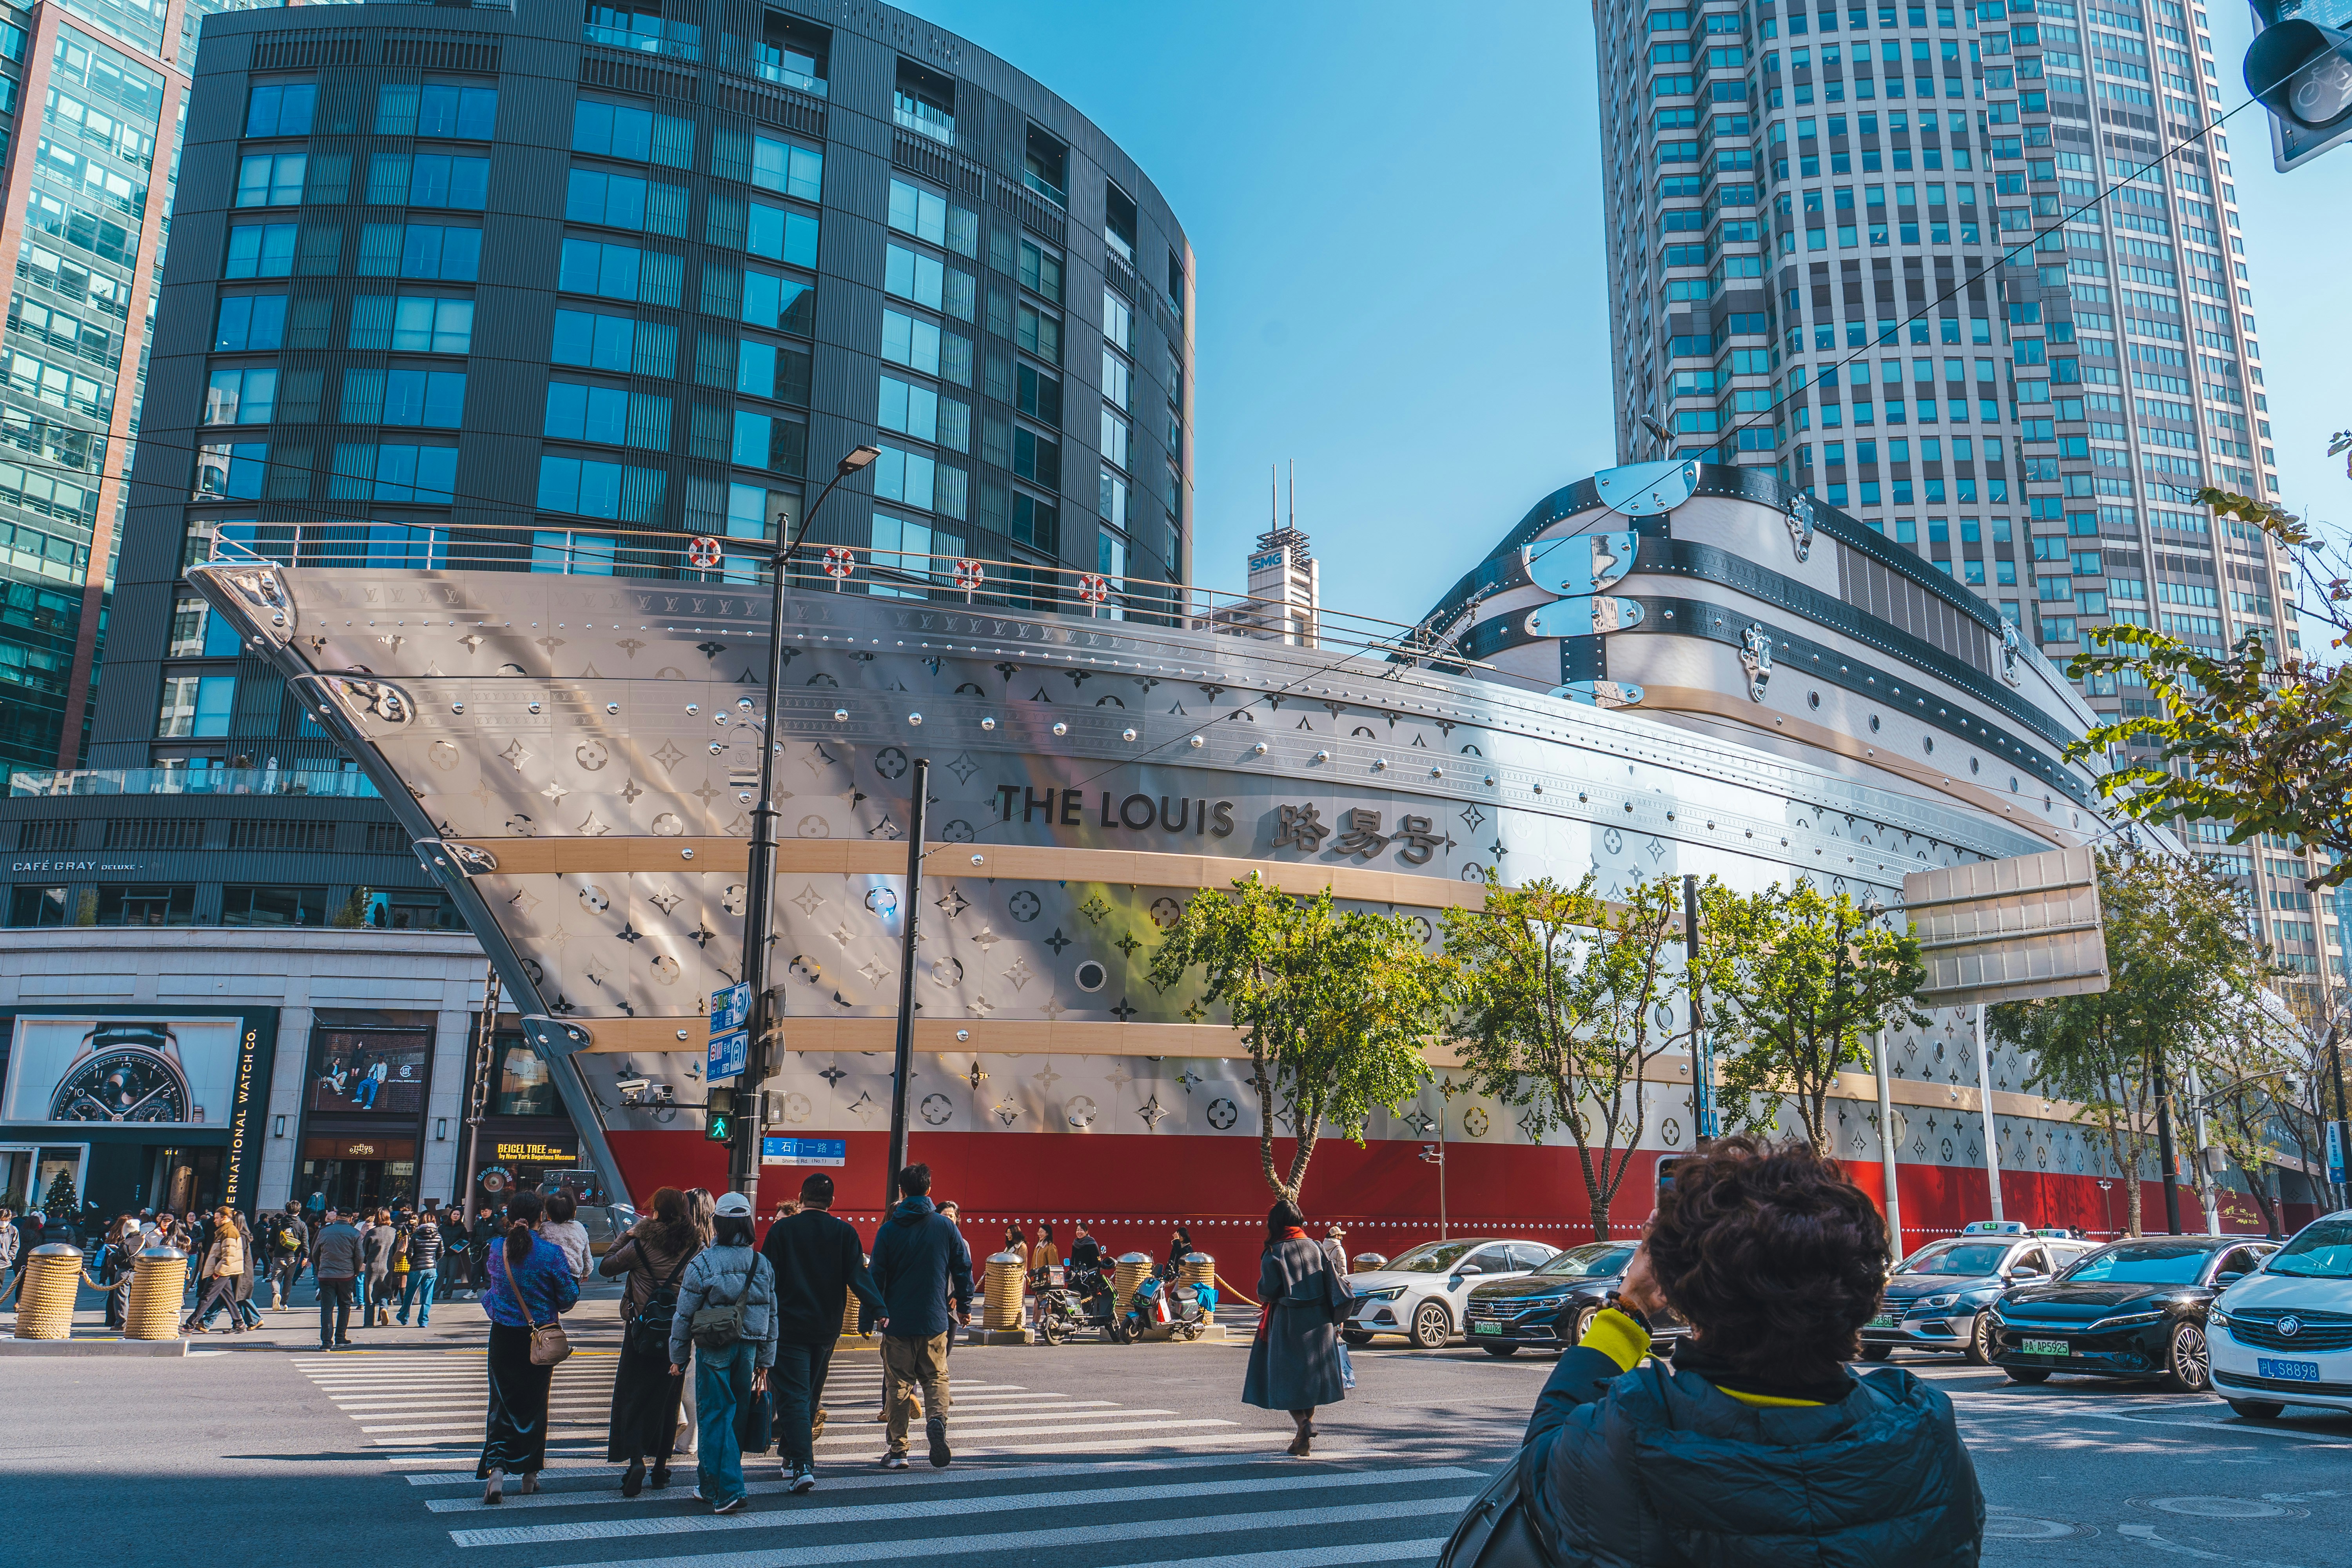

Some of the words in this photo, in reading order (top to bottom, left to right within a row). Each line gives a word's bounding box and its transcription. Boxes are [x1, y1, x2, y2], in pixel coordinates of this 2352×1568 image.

[1251, 552, 1282, 571] SMG
[996, 784, 1083, 826] THE
[1100, 790, 1235, 837] LOUIS
[1272, 802, 1446, 864] 路易号
[13, 860, 50, 871] CAFÉ
[54, 862, 96, 870] GRAY
[719, 996, 722, 1009] 2
[723, 995, 728, 1007] 12
[723, 1042, 730, 1054] 号线
[95, 1070, 103, 1078] 11
[74, 1088, 85, 1097] 10
[162, 1089, 171, 1098] 2
[226, 1110, 247, 1210] ERNATIONAL
[239, 1054, 253, 1103] WATCH
[246, 1029, 257, 1050] CO.
[498, 1144, 525, 1153] BEIGEL
[526, 1144, 547, 1154] TREE
[781, 1142, 827, 1153] 石门一路
[477, 1166, 513, 1182] 纽约贝果博物馆
[2038, 1342, 2067, 1354] AP5925
